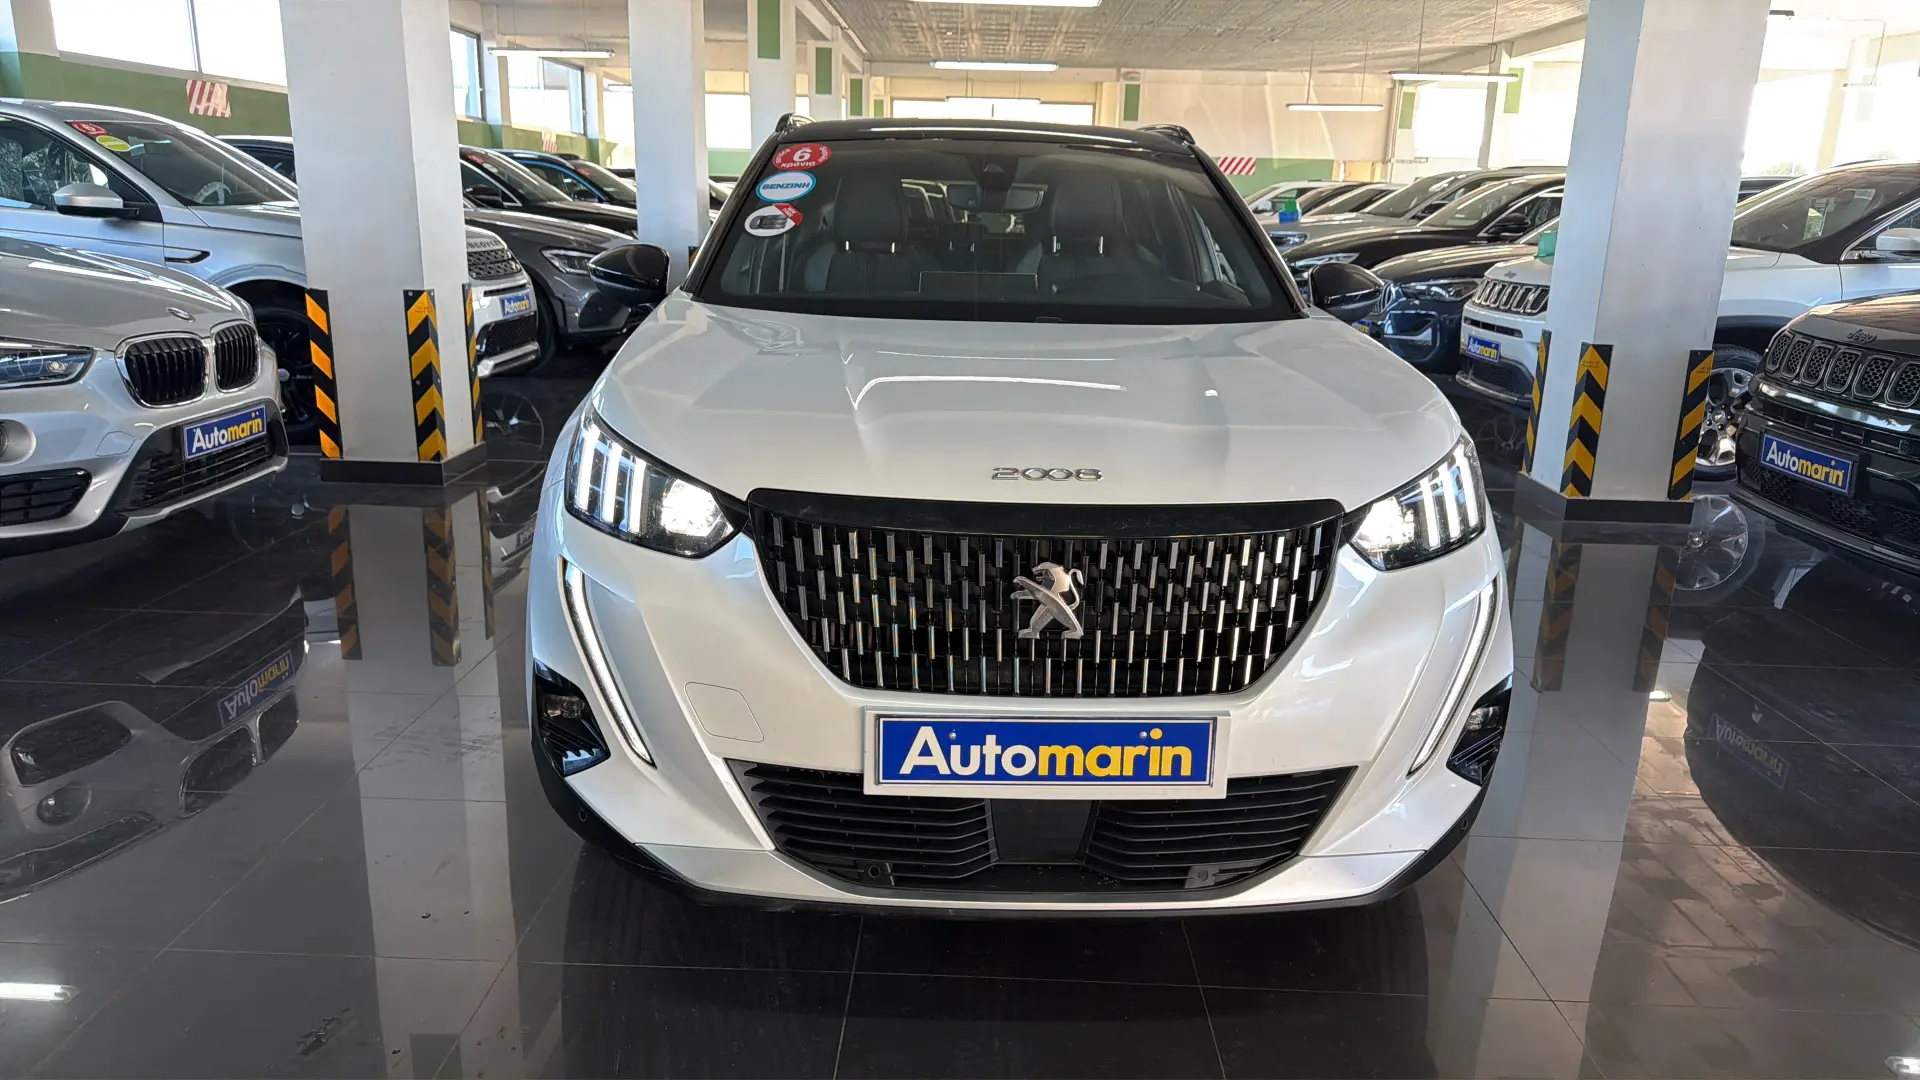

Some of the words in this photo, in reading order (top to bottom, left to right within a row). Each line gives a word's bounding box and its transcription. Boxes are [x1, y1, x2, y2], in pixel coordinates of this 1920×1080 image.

[793, 148, 812, 162] 6
[1847, 329, 1878, 344] Jeep
[1467, 337, 1497, 359] Automarin
[191, 411, 263, 454] Automarin
[991, 467, 1105, 482] 2008
[1766, 440, 1845, 488] Automarin
[899, 725, 1192, 777] Automarin
